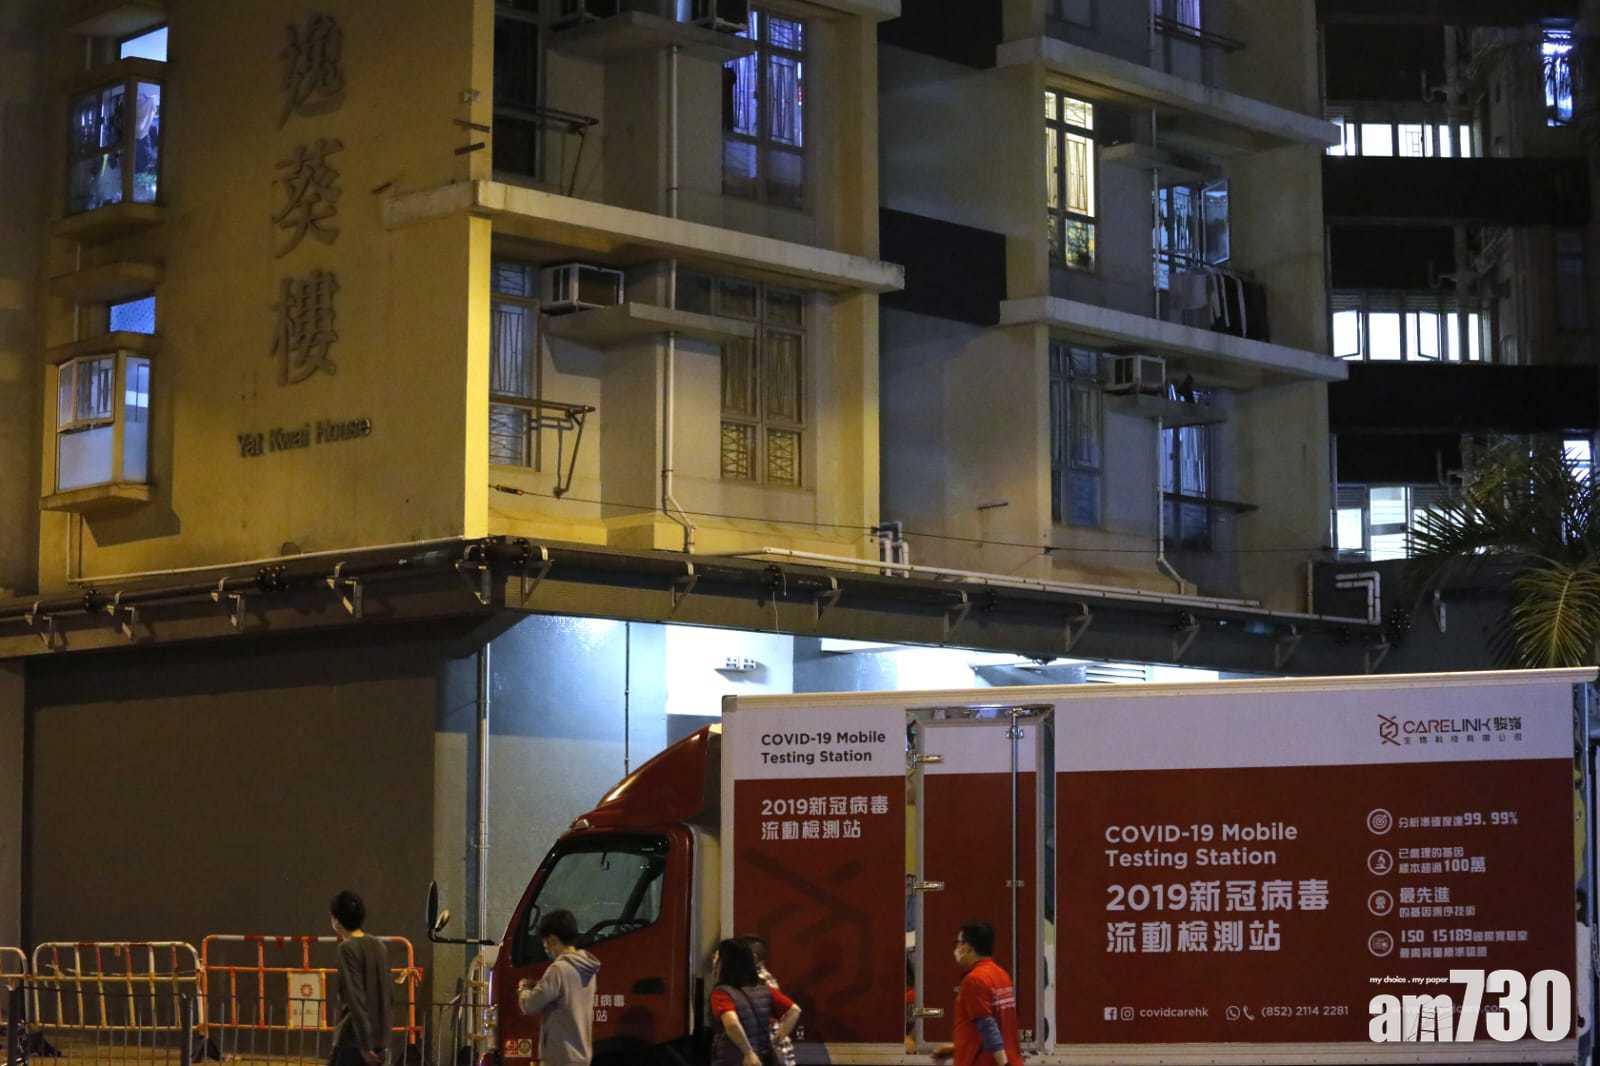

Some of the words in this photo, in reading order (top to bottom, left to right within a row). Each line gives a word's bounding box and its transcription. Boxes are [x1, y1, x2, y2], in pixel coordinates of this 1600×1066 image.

[269, 422, 311, 452] Kwai
[316, 418, 372, 444] House
[1402, 718, 1492, 734] CARELINK
[760, 731, 832, 747] COVID-19
[836, 729, 887, 744] Mobile
[760, 750, 815, 766] Testing
[819, 749, 873, 763] Station
[760, 795, 889, 816] 2019新冠病毒
[760, 819, 862, 841] 流動檢測站
[1104, 823, 1214, 843] COVID-19
[1222, 822, 1298, 842] Mobile
[1104, 849, 1188, 870] Testing
[1195, 847, 1277, 866] Station
[1105, 878, 1329, 913] 2019新冠病毒
[1105, 919, 1281, 954] 流動檢測站
[1400, 929, 1425, 943] ISO
[1139, 1007, 1209, 1018] covidcarehk
[1260, 1005, 1293, 1018] (852)
[1295, 1005, 1320, 1017] 2114
[1322, 1005, 1349, 1016] 2281
